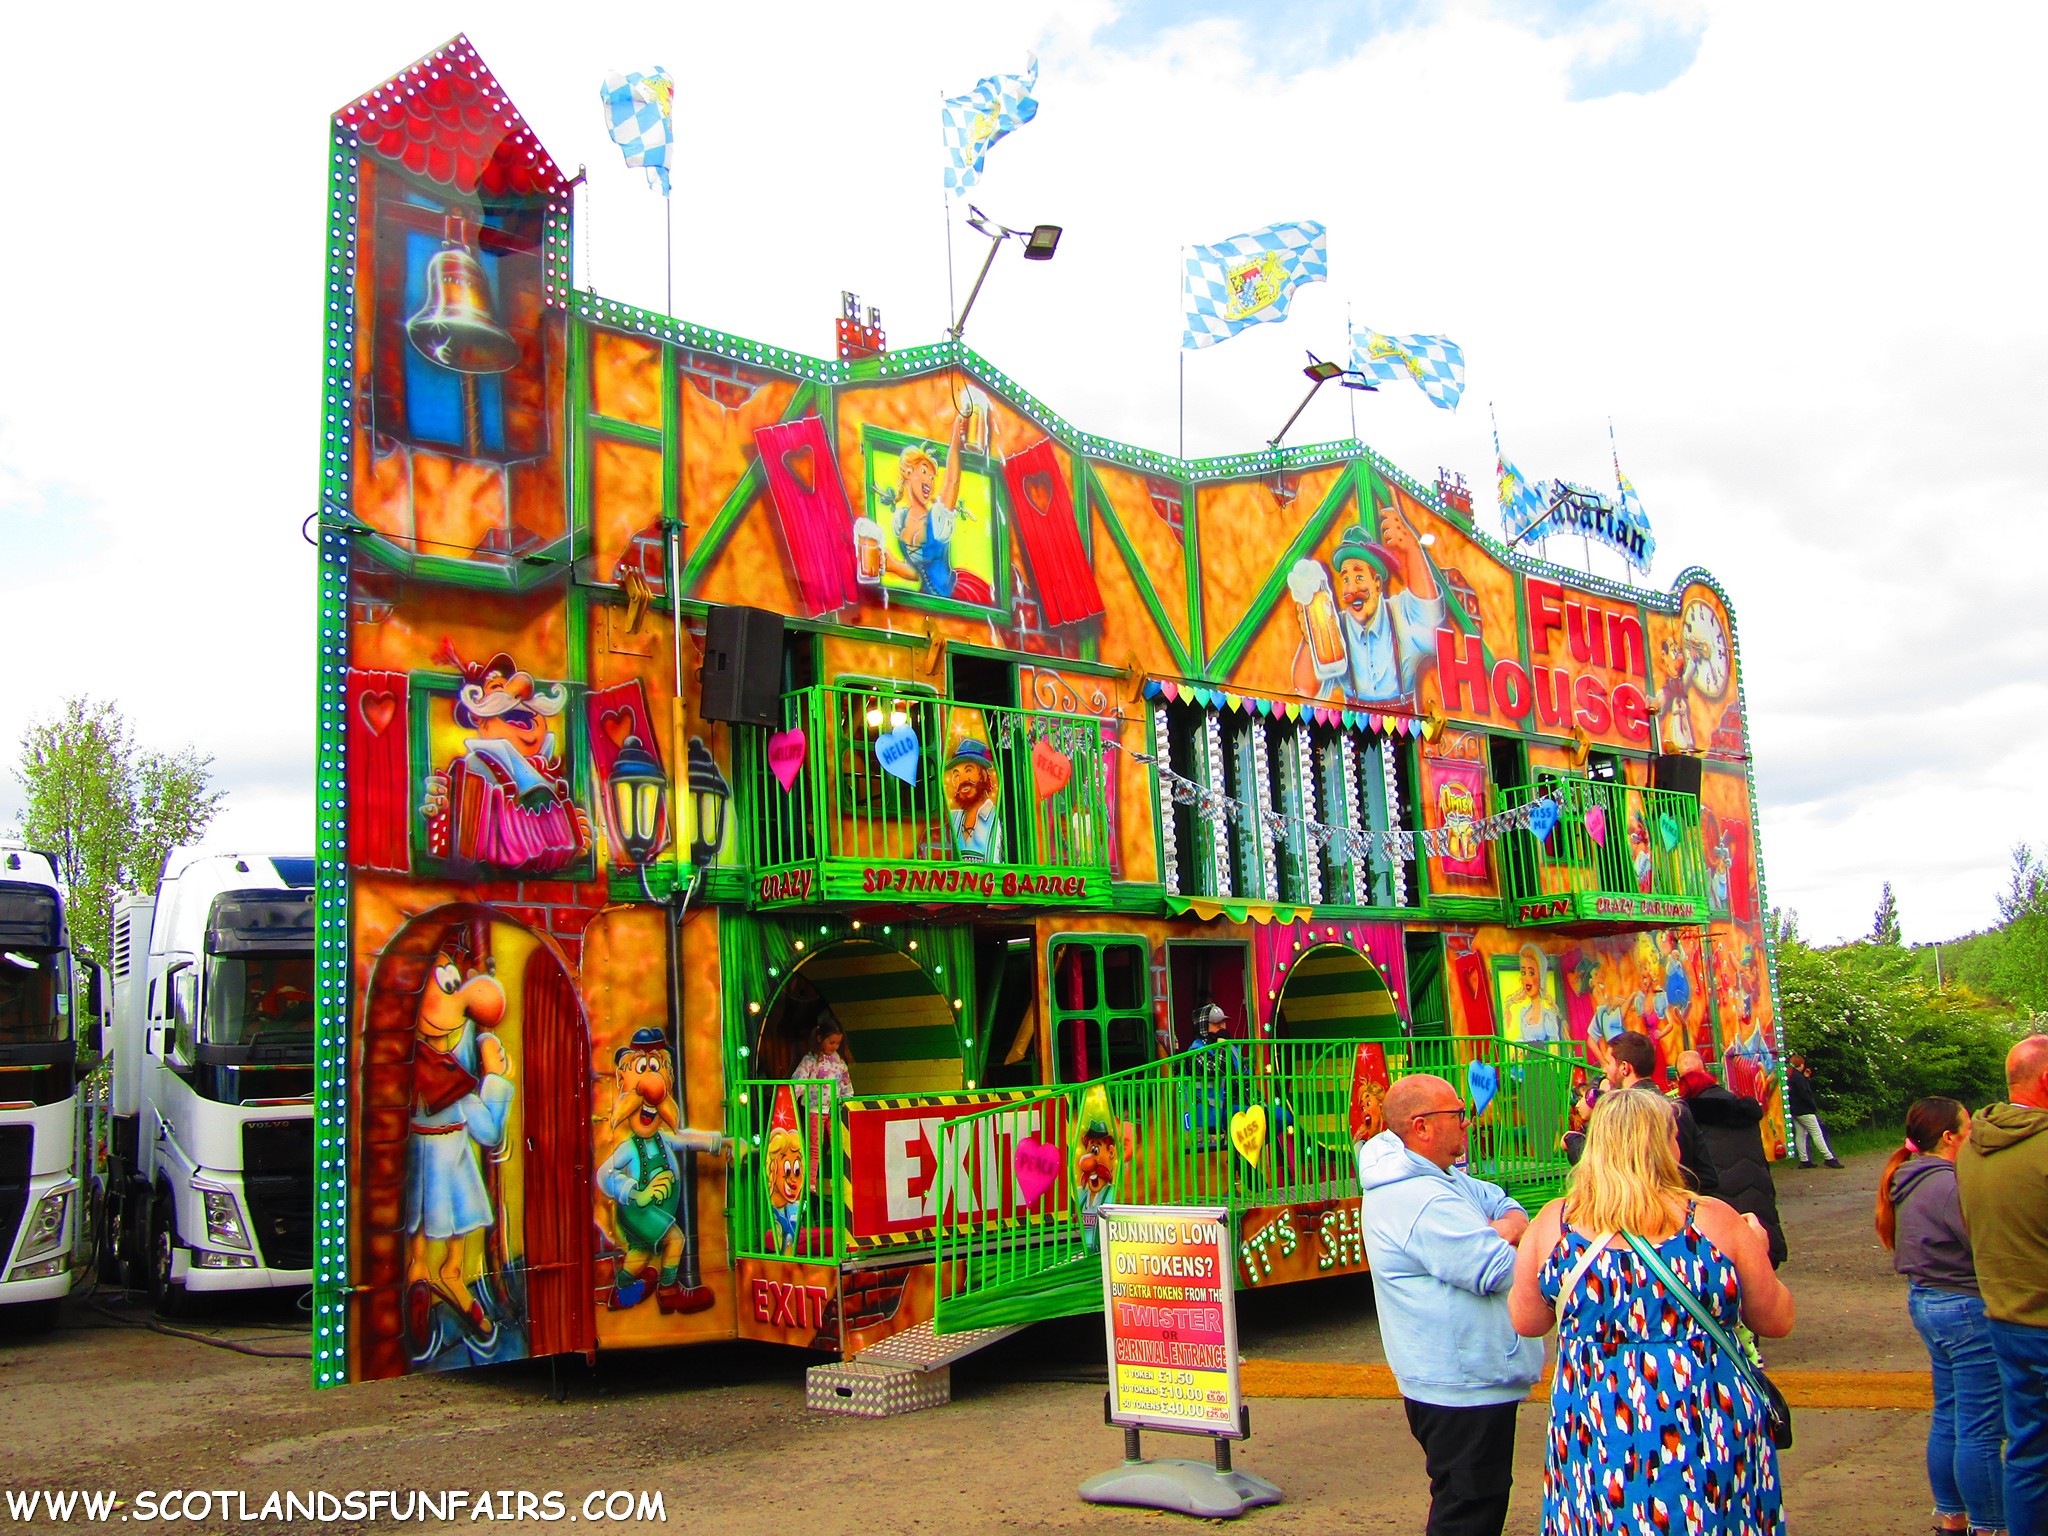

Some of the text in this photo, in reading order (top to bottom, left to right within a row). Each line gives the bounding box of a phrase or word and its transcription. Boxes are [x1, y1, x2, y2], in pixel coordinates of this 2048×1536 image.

[1545, 495, 1646, 559] avarian
[1526, 574, 1646, 678] Fun
[1436, 628, 1649, 742] House
[882, 737, 914, 765] HELLO
[1037, 754, 1064, 781] PEACE
[1530, 807, 1551, 818] KISS
[1534, 820, 1547, 829] ME
[760, 867, 1088, 901] CRAZY SPINNING BARREL
[1519, 897, 1694, 922] FUN CRAZY CAR WASH
[1471, 1073, 1491, 1091] NICE
[247, 1121, 290, 1129] VOLVO
[1236, 1120, 1259, 1143] KISS
[1243, 1137, 1258, 1155] ME
[884, 1110, 1041, 1222] EXIT
[1020, 1152, 1056, 1176] PEACE
[1108, 1220, 1217, 1245] RUNNING LOW
[1241, 1207, 1362, 1284] IT'S SH
[1116, 1252, 1213, 1278] ON TOKENS?
[752, 1278, 827, 1329] EXIT
[1112, 1283, 1127, 1297] BUY
[1129, 1284, 1151, 1299] EXTRA
[1153, 1285, 1183, 1300] TOKENS
[1185, 1287, 1206, 1302] FROM
[1117, 1303, 1222, 1332] TWISTER
[1162, 1330, 1178, 1340] OR
[1115, 1337, 1227, 1369] CARNIVAL ENTRANCE
[1131, 1370, 1153, 1380] TOKEN
[1158, 1370, 1194, 1385] £1.50
[1120, 1384, 1203, 1401] 10 TOKENS £10.00
[1206, 1394, 1225, 1403] £5.00
[1122, 1399, 1204, 1417] 50 TOKENS £40.00
[1206, 1411, 1229, 1420] £25.00
